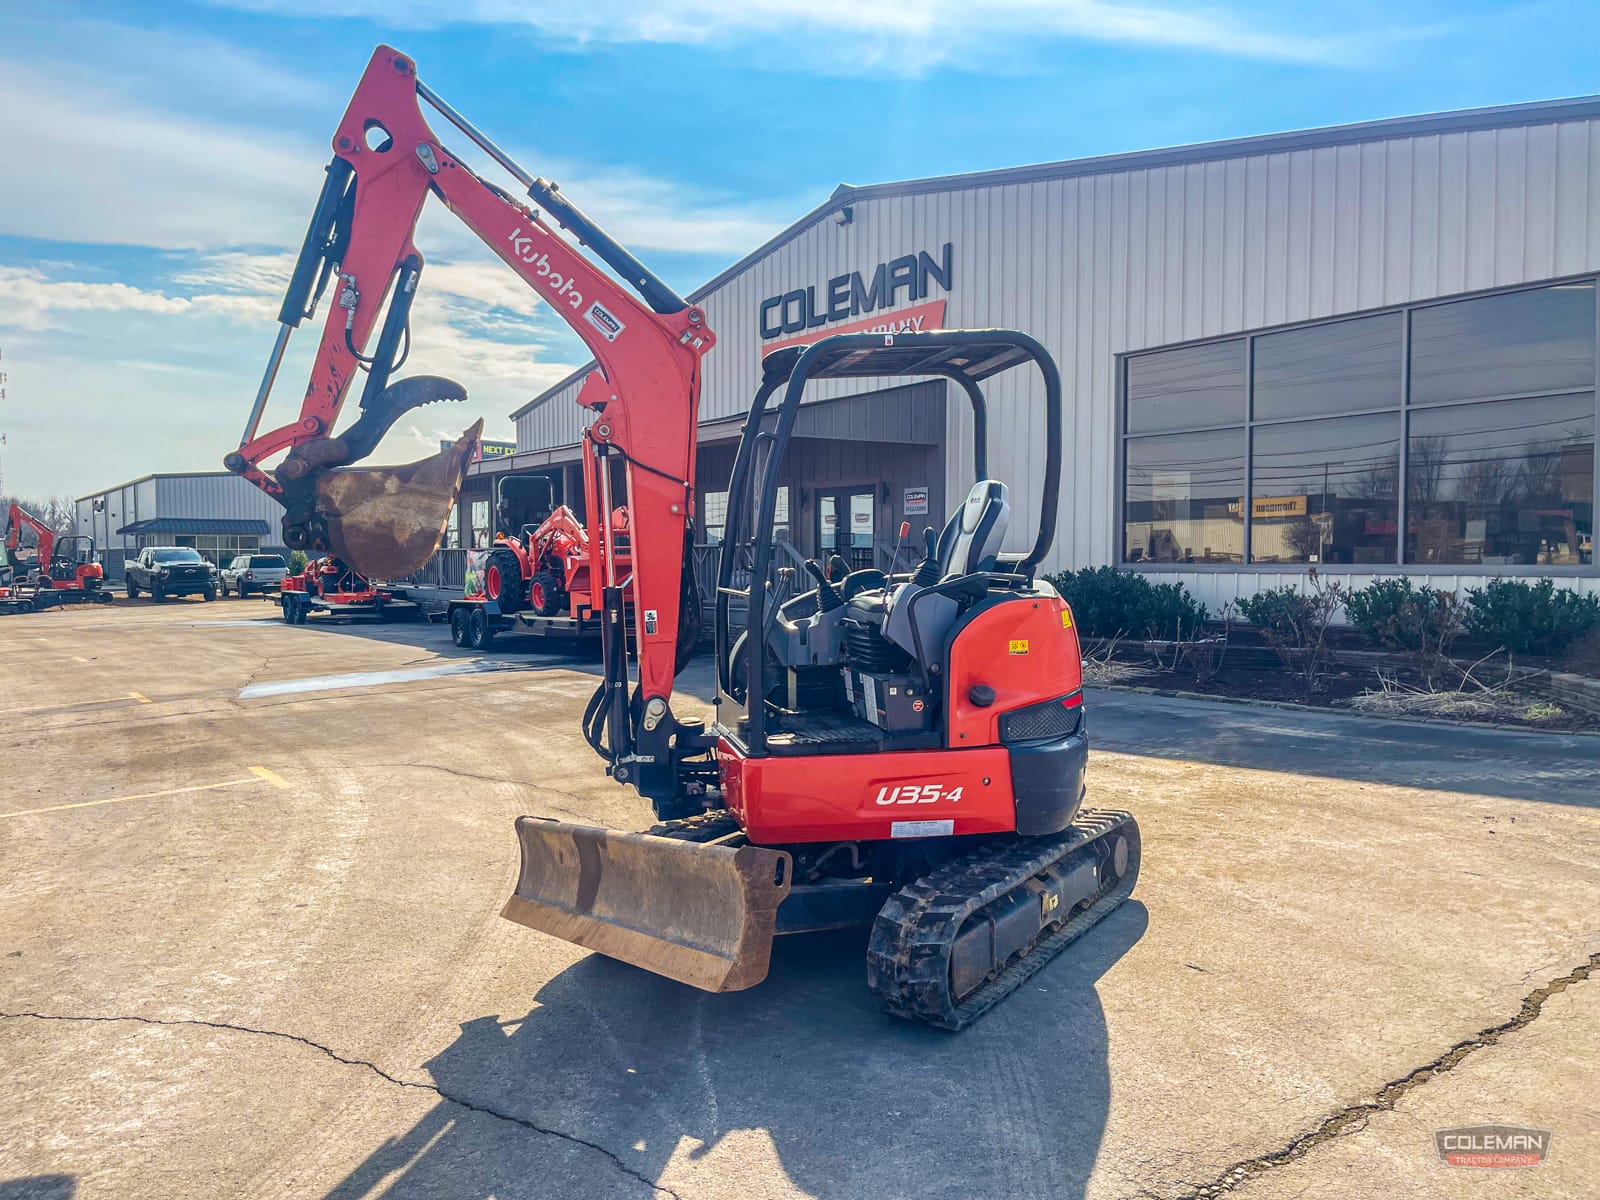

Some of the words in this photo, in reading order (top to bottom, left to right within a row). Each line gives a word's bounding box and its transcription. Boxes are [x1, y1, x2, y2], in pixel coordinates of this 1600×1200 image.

[508, 228, 583, 309] Kubota
[760, 242, 952, 339] COLEMAN
[483, 445, 503, 455] NEXT
[875, 784, 964, 805] U35-4
